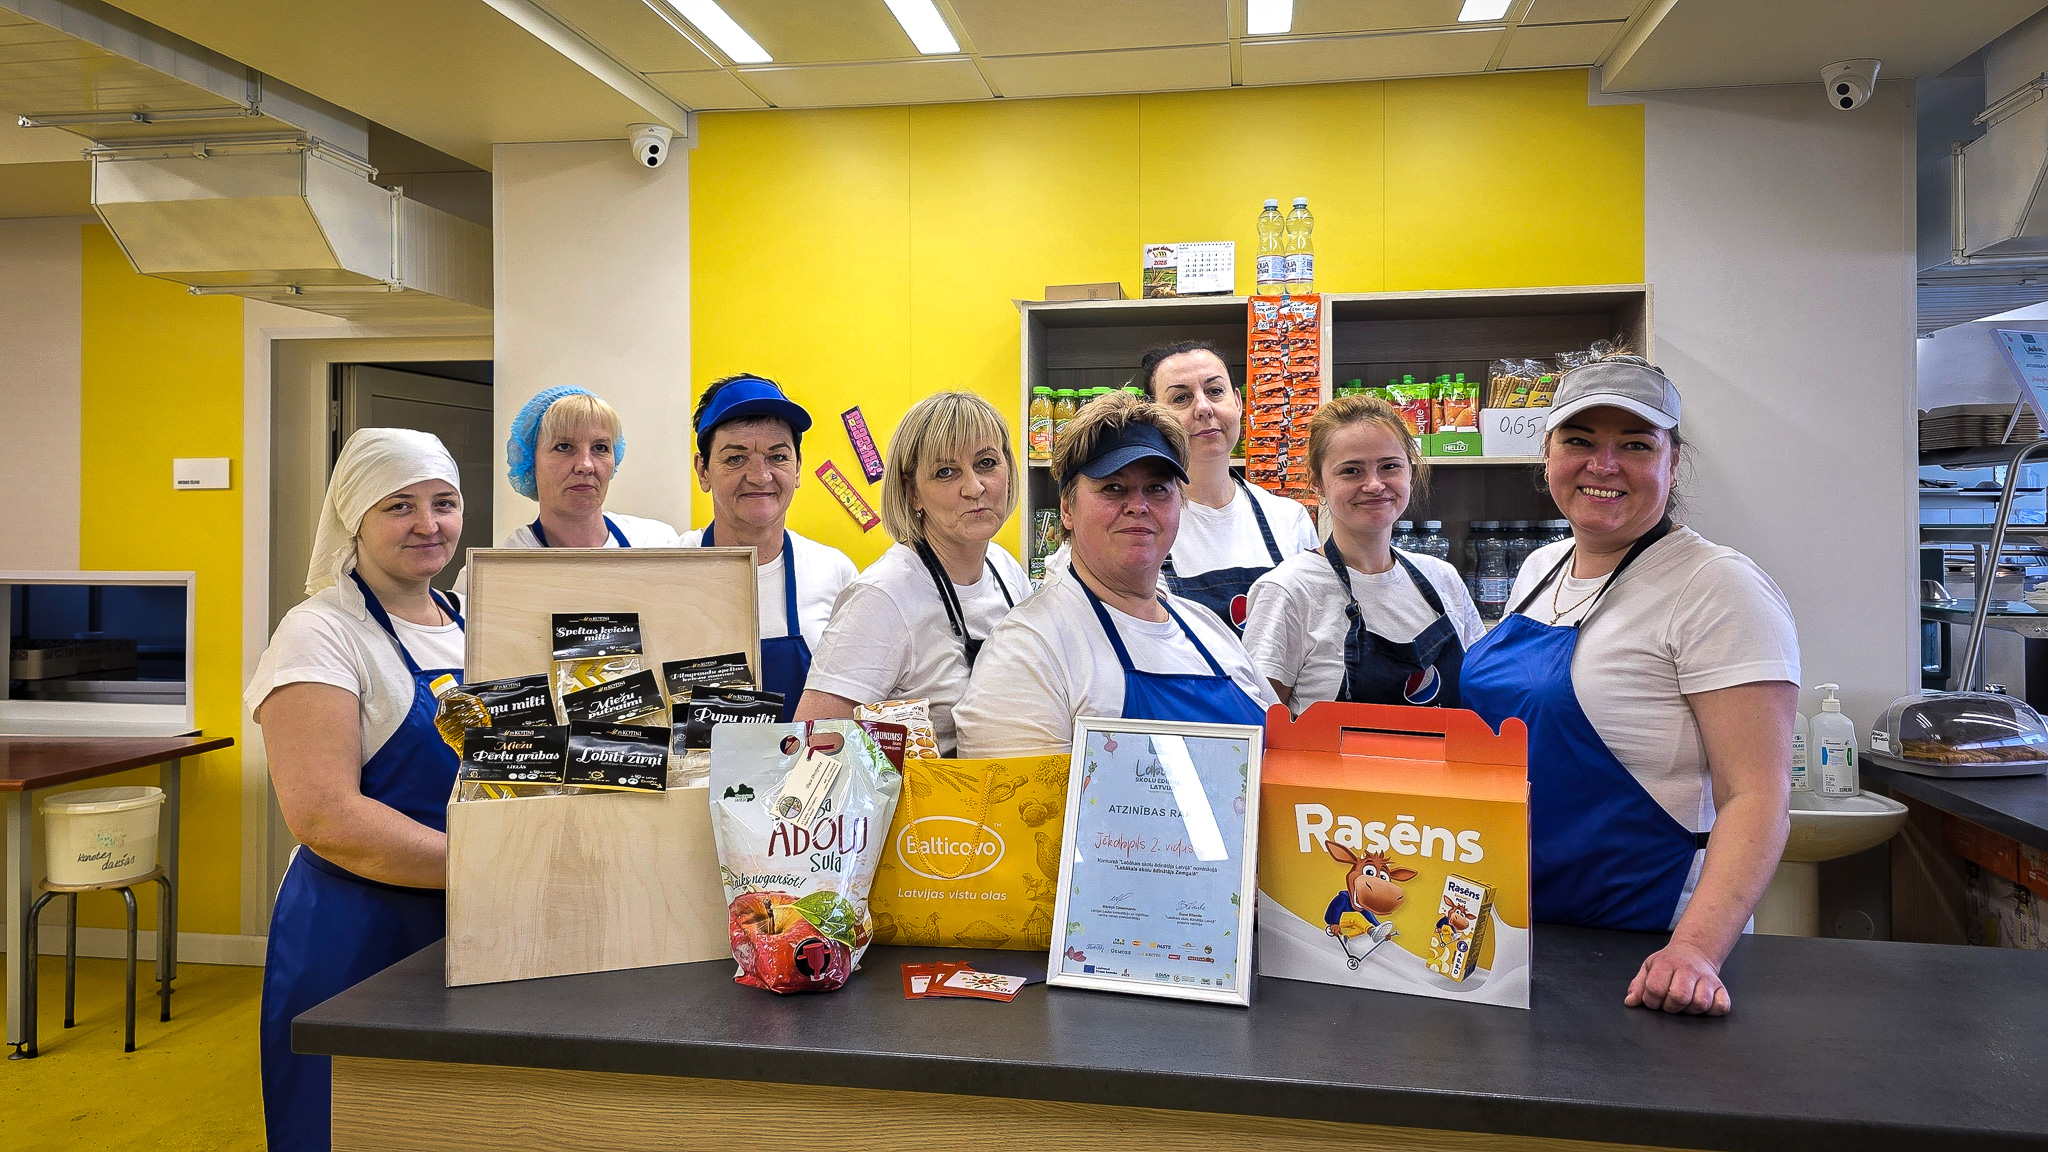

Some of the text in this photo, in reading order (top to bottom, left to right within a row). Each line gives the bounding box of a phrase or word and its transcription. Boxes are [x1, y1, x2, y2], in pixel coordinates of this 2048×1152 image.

[1500, 416, 1542, 438] 0,65
[556, 626, 598, 637] Speltas
[584, 633, 610, 641] milti
[487, 695, 545, 716] ņu milti
[588, 692, 634, 713] Miežu
[588, 696, 642, 719] putraimi
[694, 707, 776, 723] Pupu milti
[494, 741, 532, 751] Miežu
[516, 750, 559, 762] grūbas
[576, 747, 663, 767] Lobīti zirņi
[1108, 804, 1165, 817] ATZINĪBAS
[1294, 803, 1484, 864] Rasēns
[906, 836, 996, 856] Balticovo
[1095, 832, 1196, 858] Jēkabpils 2. vidus
[752, 873, 807, 888] nogaršot!
[898, 888, 1007, 901] Latvijas vistu olas
[1448, 882, 1480, 900] Rasēns
